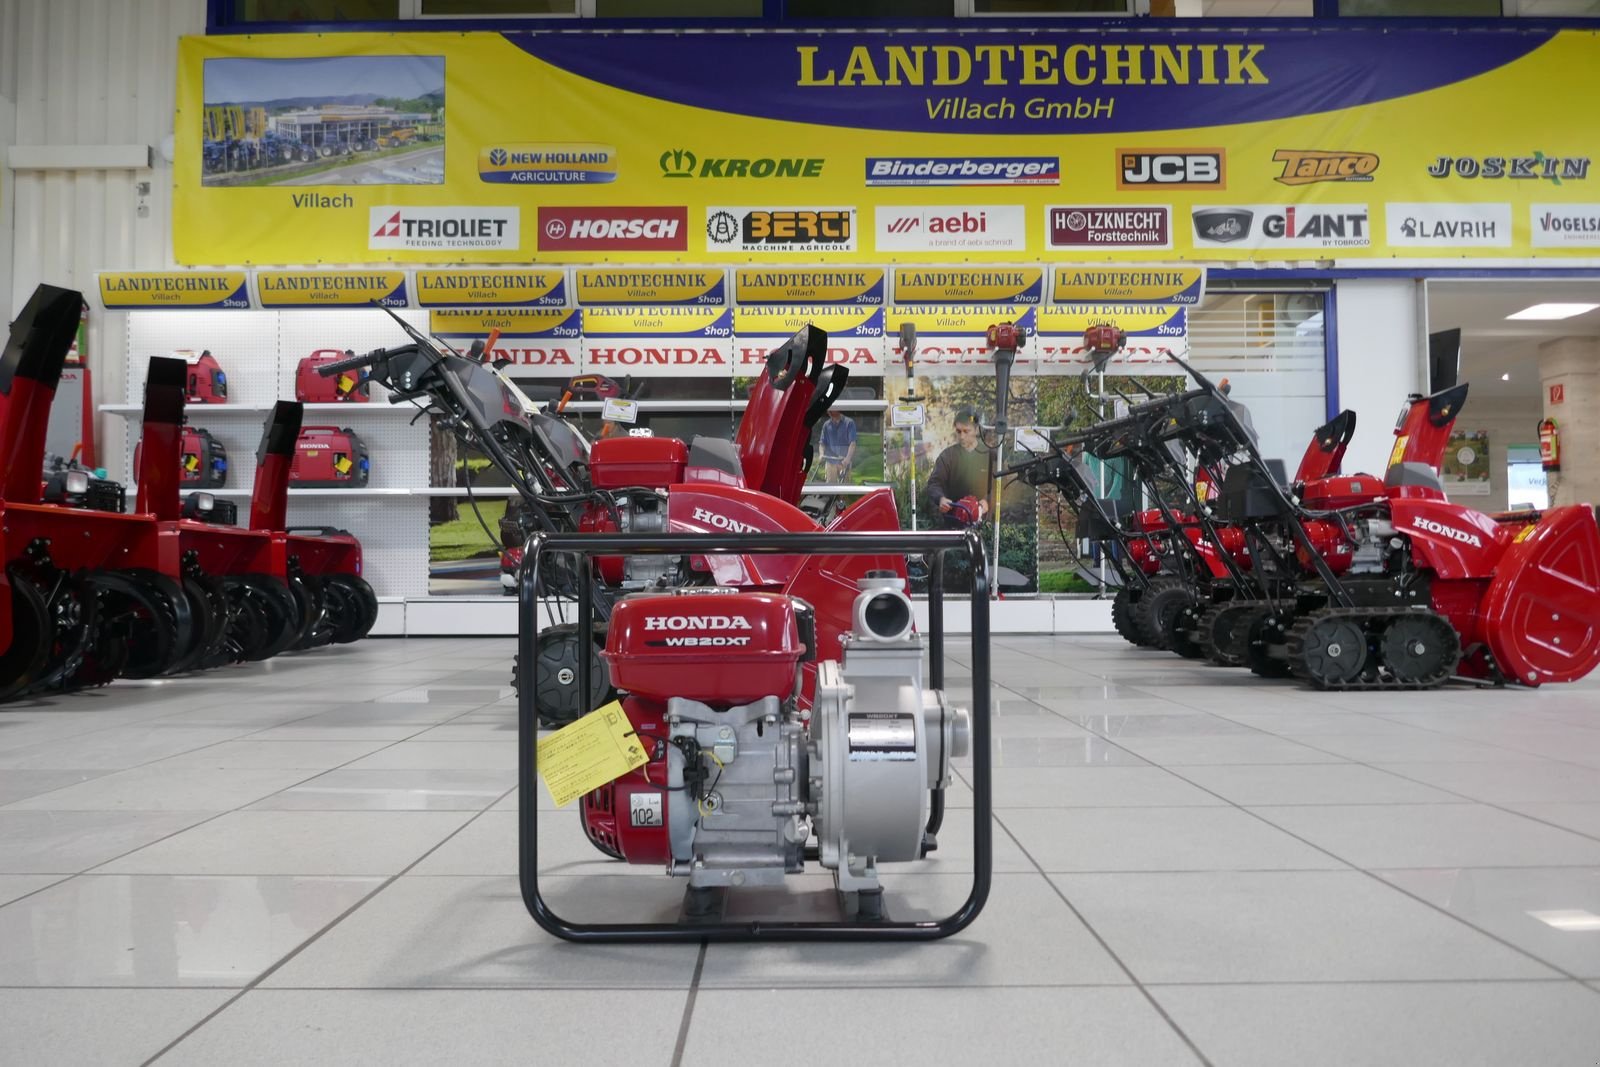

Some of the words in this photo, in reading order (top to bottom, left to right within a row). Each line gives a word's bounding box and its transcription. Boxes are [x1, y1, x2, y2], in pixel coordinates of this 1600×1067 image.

[797, 44, 1268, 86] LANDTECHNIK
[926, 97, 1015, 119] Villach
[1023, 97, 1114, 119] GmbH
[511, 153, 542, 164] NEW
[545, 153, 608, 164] HOLLAND
[699, 158, 825, 178] KRONE
[872, 160, 1055, 178] Binderberger
[1123, 155, 1219, 182] JCB
[1272, 150, 1379, 180] Tanco
[1427, 156, 1591, 180] JOSKIN
[511, 172, 586, 181] AGRICULTURE
[292, 193, 353, 208] Villach
[402, 219, 508, 237] TRIOLIET
[570, 219, 679, 238] HORSCH
[929, 212, 986, 233] aebi
[1088, 230, 1159, 241] Forsttechnik
[1419, 221, 1496, 238] LAVRIH
[105, 277, 229, 291] LANDTECHNIK
[263, 276, 389, 290] LANDTECHNIK
[422, 275, 547, 289] LANDTECHNIK
[582, 274, 707, 287] LANDTECHNIK
[741, 274, 866, 287] LANDTECHNIK
[901, 273, 1025, 286] LANDTECHNIK
[1061, 273, 1184, 286] LANDTECHNIK
[152, 293, 181, 301] Villach
[309, 291, 340, 300] Villach
[467, 290, 497, 298] Villach
[627, 289, 656, 297] Villach
[944, 288, 974, 296] Villach
[1103, 288, 1133, 296] Villach
[1172, 293, 1196, 303] Shop
[223, 299, 247, 309] Shop
[380, 297, 406, 307] Shop
[539, 295, 564, 305] Shop
[698, 295, 722, 305] Shop
[856, 295, 881, 304] Shop
[1013, 294, 1038, 303] Shop
[482, 319, 512, 328] Villach
[633, 319, 663, 327] Villach
[936, 318, 966, 326] Villach
[553, 326, 578, 336] Shop
[704, 326, 729, 336] Shop
[855, 325, 880, 335] Shop
[1157, 325, 1182, 335] Shop
[589, 348, 726, 364] HONDA
[740, 348, 877, 364] HDA
[1412, 516, 1482, 548] HONDA
[644, 616, 752, 630] HONDA
[665, 637, 751, 646] WB20XT
[632, 808, 653, 824] 102
